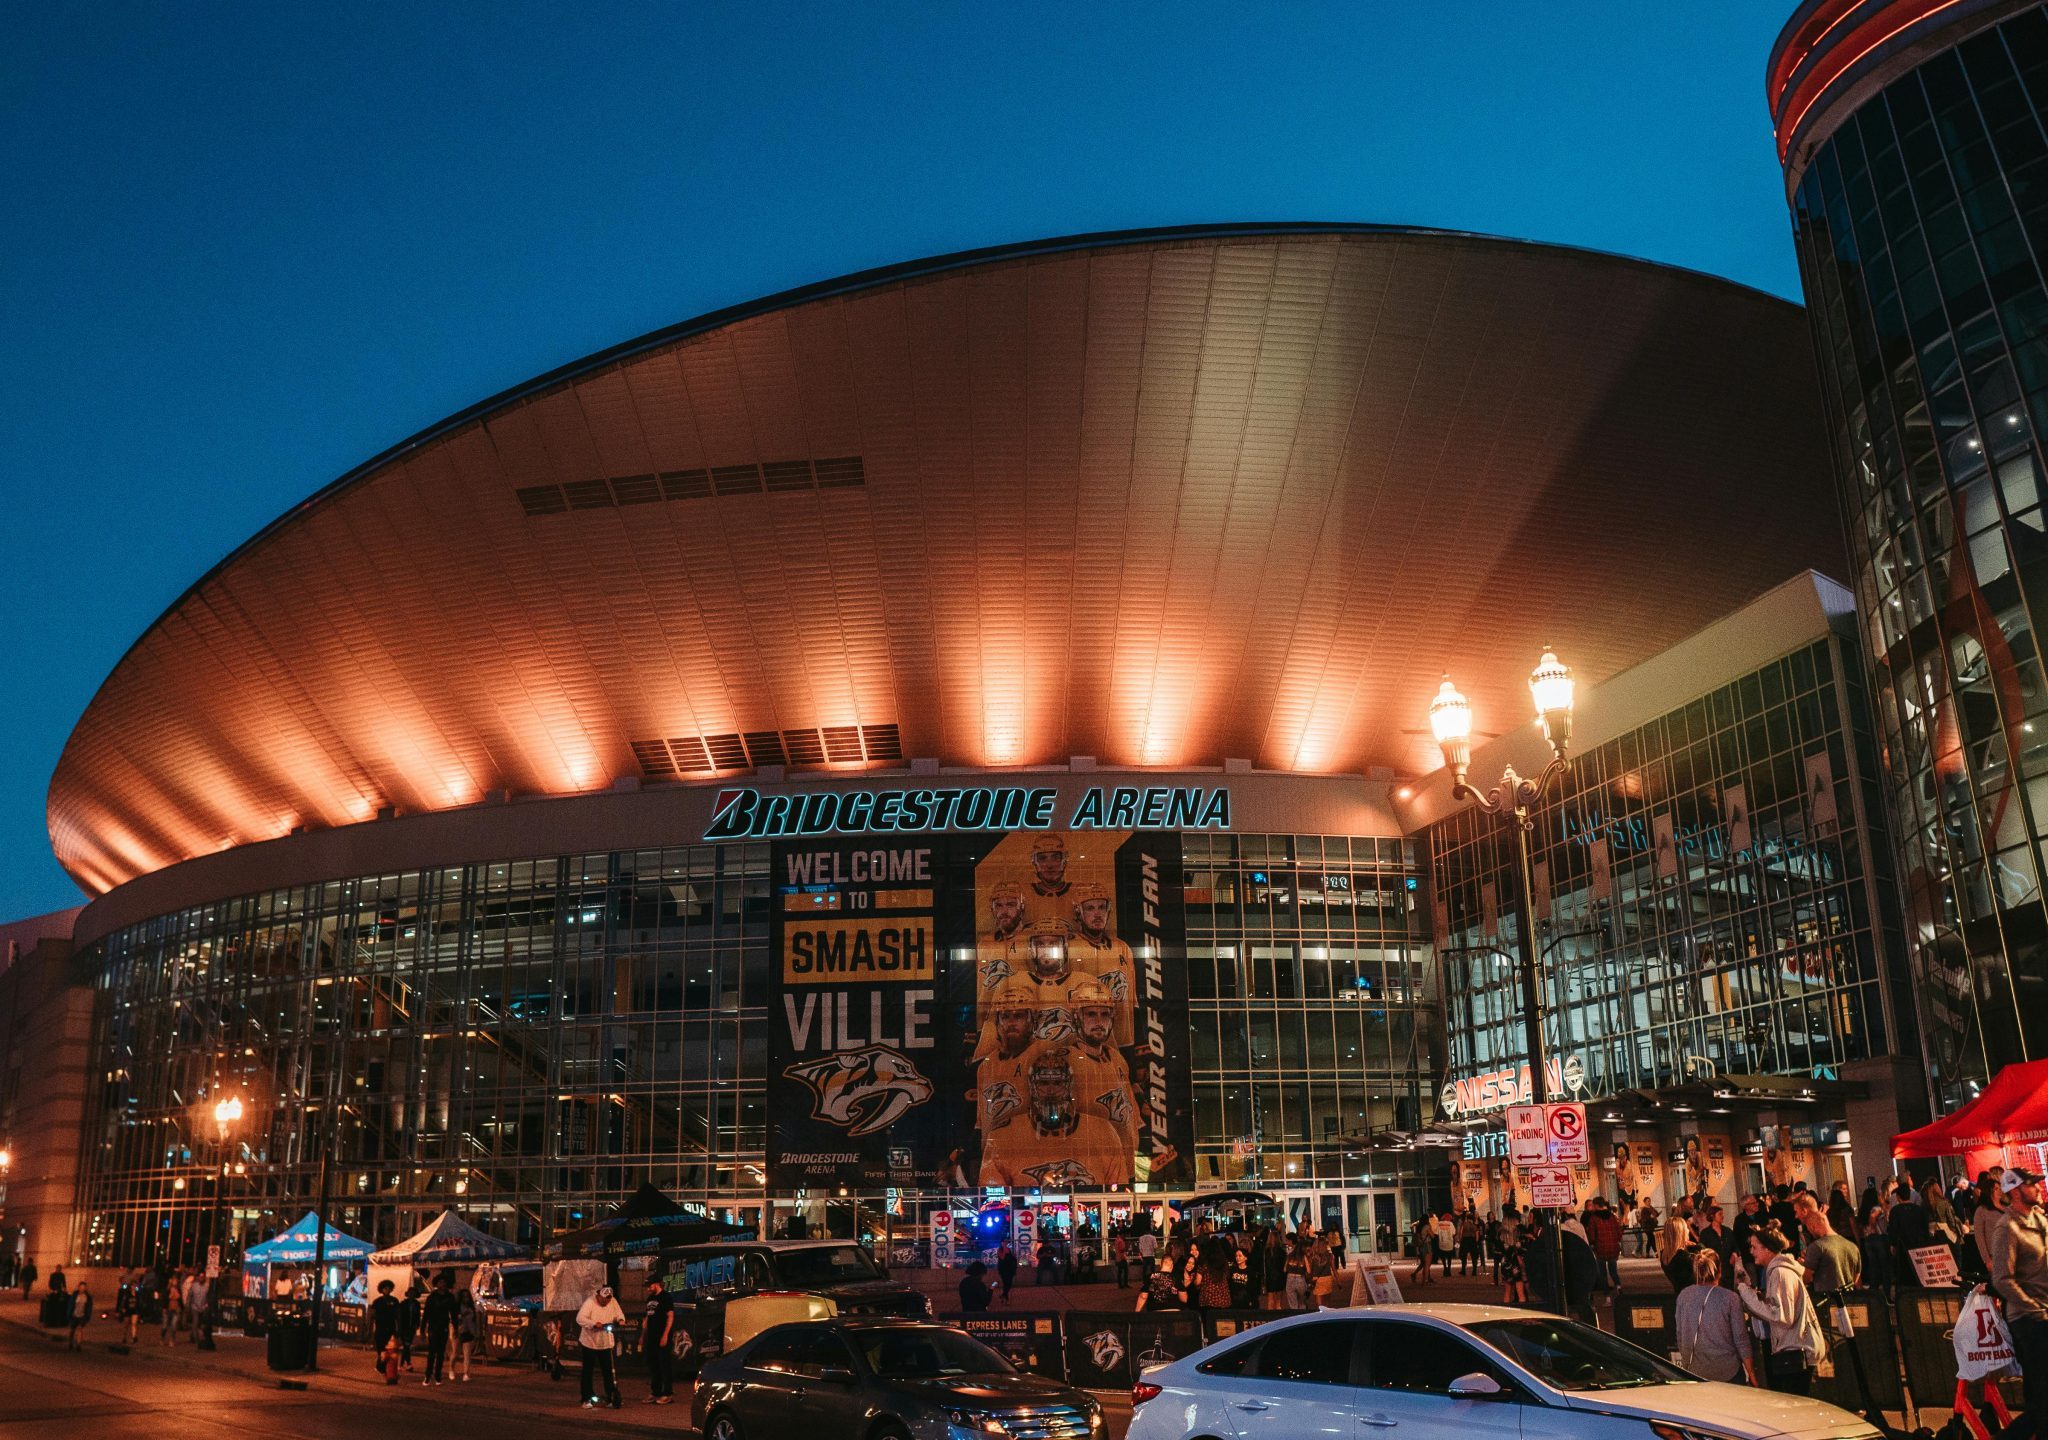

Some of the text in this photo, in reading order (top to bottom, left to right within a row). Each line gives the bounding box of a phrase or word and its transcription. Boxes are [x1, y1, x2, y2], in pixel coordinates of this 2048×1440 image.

[703, 786, 1230, 841] BRIDGESTONE ARENA
[786, 848, 932, 885] WELCOME
[848, 891, 868, 909] TO
[792, 927, 925, 973] SMASH
[1141, 853, 1168, 1155] YEAR OF THE FAN
[783, 989, 935, 1051] VILLE
[1456, 1058, 1564, 1112] NISSAN
[1520, 1113, 1531, 1123] NO
[1511, 1128, 1543, 1139] VENDING
[1990, 1129, 2048, 1144] MERCHANDIS
[780, 1153, 860, 1164] BRIDGESTONE
[1711, 1160, 1724, 1169] VILLE
[804, 1165, 836, 1174] ARENA
[889, 1170, 912, 1178] THIRD
[914, 1170, 937, 1178] BANK
[1639, 1167, 1654, 1175] VILLE
[668, 1259, 687, 1273] 107.5
[663, 1255, 735, 1292] THE RIVER
[966, 1320, 1027, 1331] EXPRESS LANES
[1967, 1348, 2015, 1361] BOOT BAR
